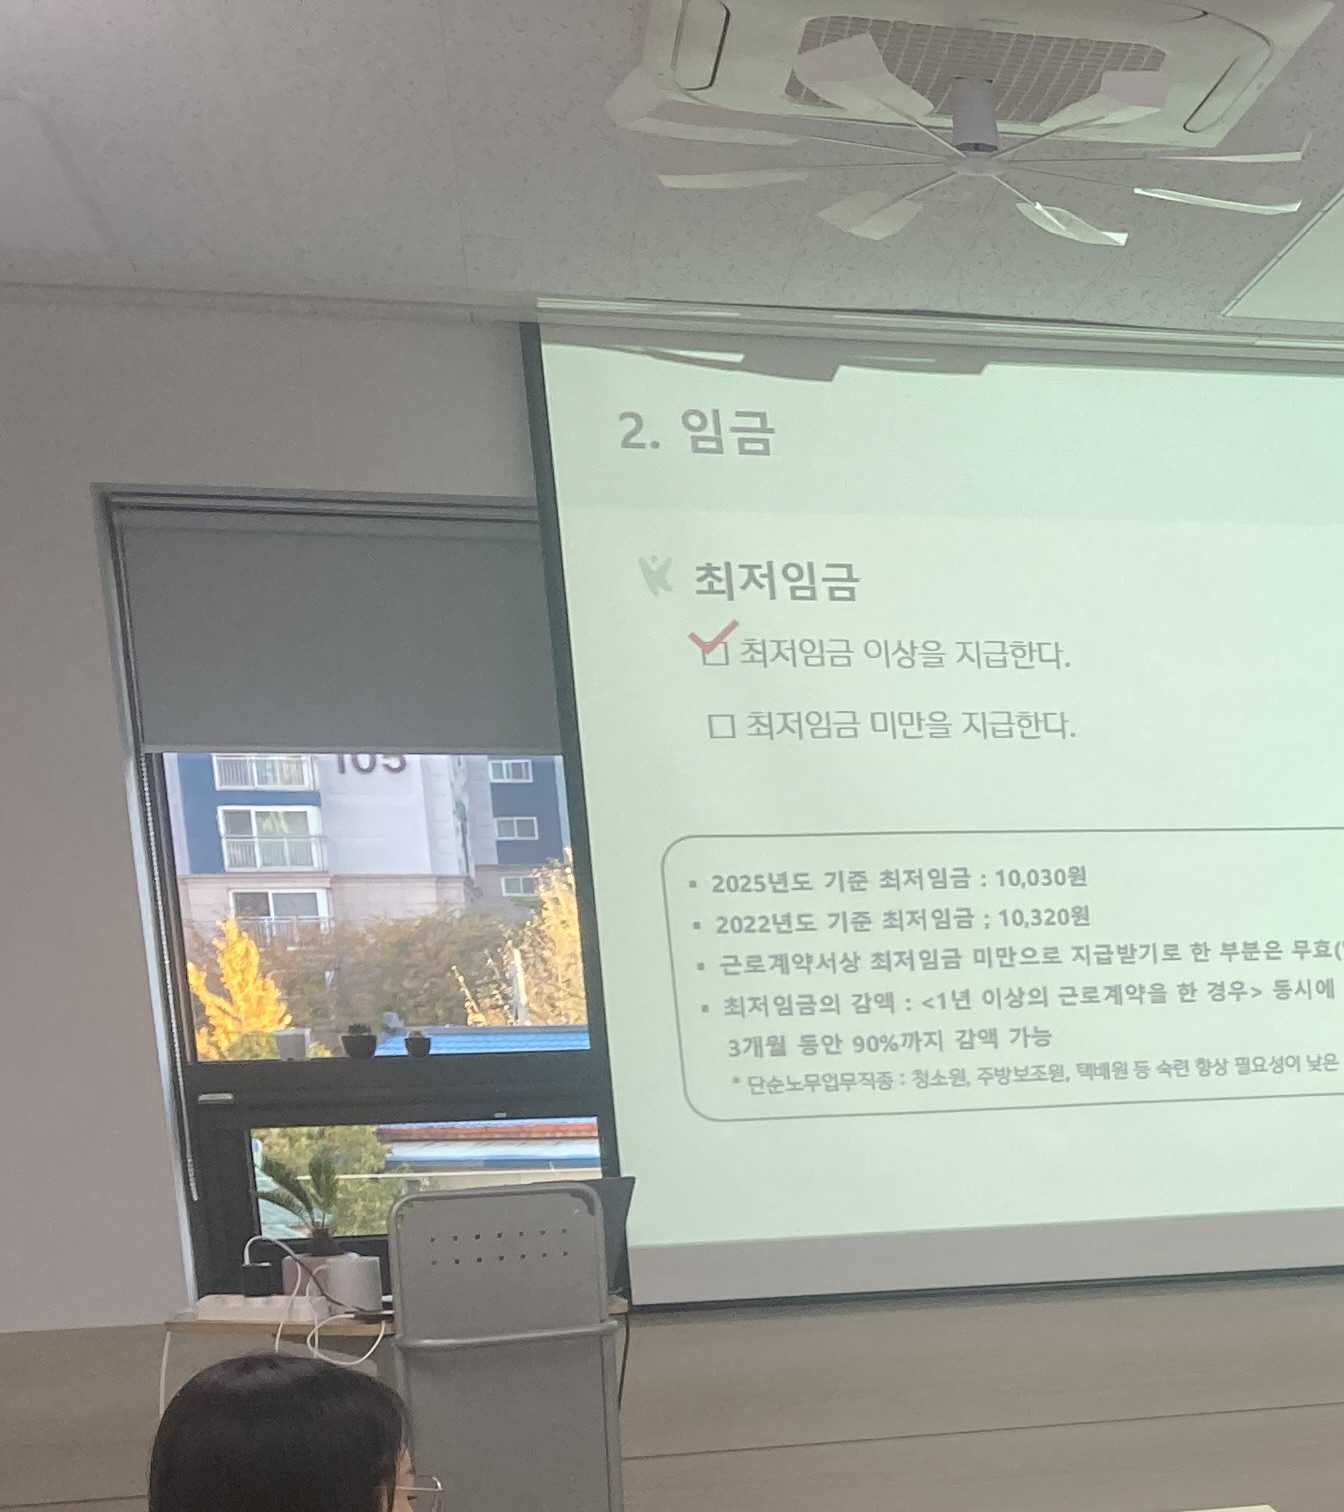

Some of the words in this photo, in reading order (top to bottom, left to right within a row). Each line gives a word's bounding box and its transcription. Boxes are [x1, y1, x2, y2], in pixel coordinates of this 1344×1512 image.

[619, 412, 660, 449] 2.
[681, 409, 776, 456] 임금
[696, 561, 860, 601] 최저임금
[740, 638, 854, 668] 최저임금
[864, 640, 946, 669] 이상을
[955, 641, 1070, 670] 지급한다.
[747, 711, 861, 740] 최저임금
[870, 711, 952, 740] 미만을
[962, 711, 1076, 740] 지급한다.
[712, 871, 813, 893] 2025년도
[824, 870, 869, 893] 기준
[880, 867, 971, 891] 최저임금
[996, 865, 1087, 889] 10,030원
[716, 912, 817, 934] 2022년도
[828, 911, 872, 934] 기준
[883, 907, 974, 932] 최저임금
[999, 905, 1090, 928] 10,320원
[720, 951, 861, 976] 근로계약서상
[871, 948, 962, 972] 최저임금
[973, 946, 1062, 969] 미만으로
[1071, 943, 1182, 966] 지급받기로
[1190, 942, 1211, 962] 한
[1220, 940, 1283, 962] 부분은
[724, 993, 840, 1018] 최저임금의
[851, 992, 895, 1014] 감액
[922, 989, 971, 1010] <1년
[982, 986, 1048, 1010] 이상의
[1058, 983, 1168, 1006] 근로계약을
[1177, 982, 1198, 1003] 한
[1207, 981, 1262, 1002] 경우>
[1273, 978, 1335, 1000] 동시에
[728, 1035, 787, 1058] 3개월
[797, 1034, 843, 1056] 동안
[853, 1029, 943, 1053] 90%까지
[955, 1028, 998, 1050] 감액
[1009, 1026, 1052, 1048] 가능
[747, 1071, 893, 1095] 단순노무업무직종
[912, 1068, 971, 1089] 청소원,
[977, 1064, 1070, 1086] 주방보조원,
[1076, 1061, 1128, 1081] 택배원
[1133, 1061, 1151, 1079] 등
[1155, 1059, 1189, 1078] 숙련
[1235, 1055, 1301, 1075] 필요성이
[1306, 1053, 1339, 1072] 낮은
